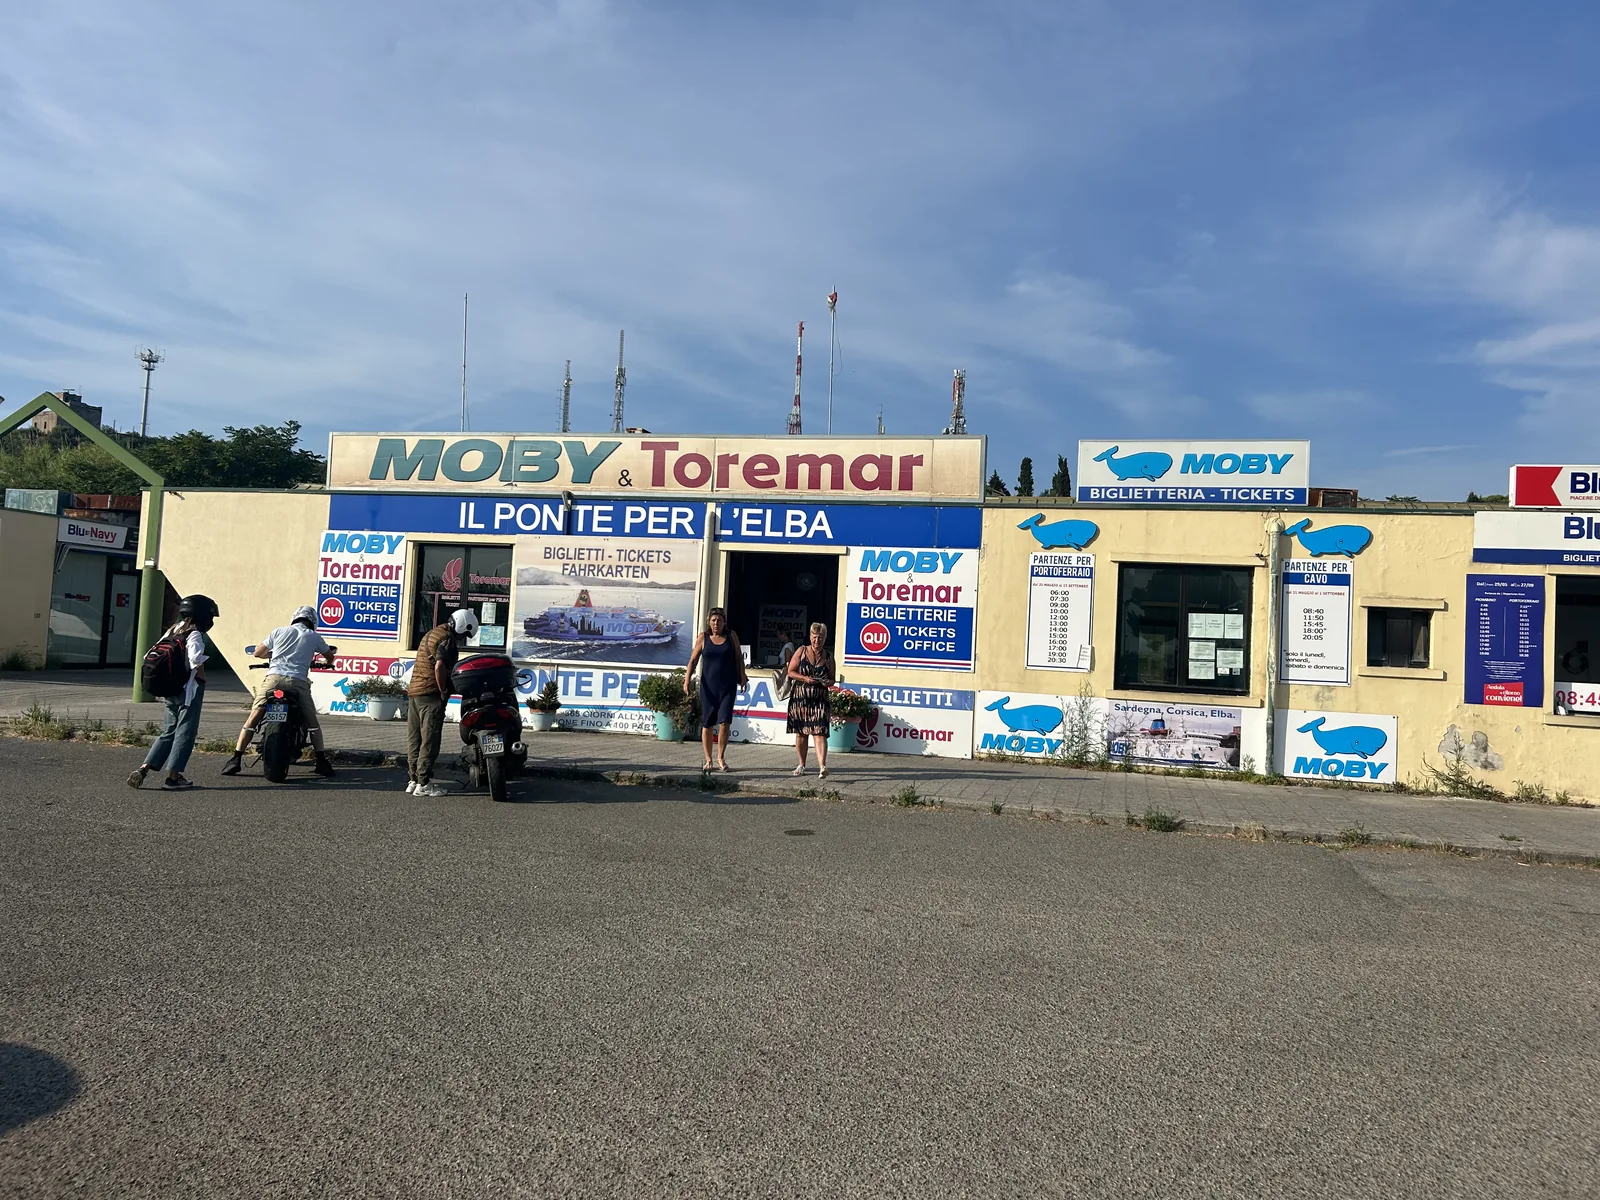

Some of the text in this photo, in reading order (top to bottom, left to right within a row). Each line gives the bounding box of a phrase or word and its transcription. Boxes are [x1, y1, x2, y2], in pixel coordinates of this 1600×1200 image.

[369, 438, 924, 491] MOBY & Toremar
[1180, 453, 1294, 475] MOBY
[1570, 472, 1600, 493] Bl
[1090, 488, 1205, 500] BIGLIETTERIA
[1220, 488, 1295, 501] TICKETS
[459, 502, 834, 539] IL PONTE PER L'ELBA
[321, 533, 405, 554] MOBY
[543, 546, 605, 561] BIGLIETTI
[616, 549, 672, 564] TICKETS
[860, 550, 963, 574] MOBY
[1033, 555, 1091, 566] PARTENZE PER
[321, 557, 402, 580] Toremar
[561, 563, 650, 579] FAHRKARTEN
[1033, 566, 1091, 577] PORTOFERRAIO
[1284, 561, 1348, 572] PARTENZE PER
[469, 573, 511, 585] Toremar
[907, 573, 913, 583] &
[1304, 573, 1328, 584] CAVO
[320, 583, 397, 597] BIGLIETTERIE
[859, 577, 962, 603] Toremar
[322, 606, 342, 618] QUI
[348, 600, 397, 612] TICKETS
[354, 613, 396, 624] OFFICE
[861, 606, 957, 622] BIGLIETTERIE
[606, 622, 659, 634] MOBY
[895, 625, 956, 638] TICKETS
[863, 632, 887, 645] QUI
[903, 639, 955, 652] OFFICE
[331, 658, 379, 673] CKETS
[516, 668, 593, 697] ONTE
[601, 672, 648, 699] PE
[859, 687, 953, 706] BIGLIETTI
[1556, 690, 1600, 706] 08:4
[330, 701, 367, 713] MOB
[1114, 703, 1236, 719] Sardegna, Corsica, Elba.
[580, 719, 603, 728] FINO
[884, 723, 954, 742] Toremar
[981, 733, 1064, 755] MOBY
[1293, 756, 1389, 779] MOBY
